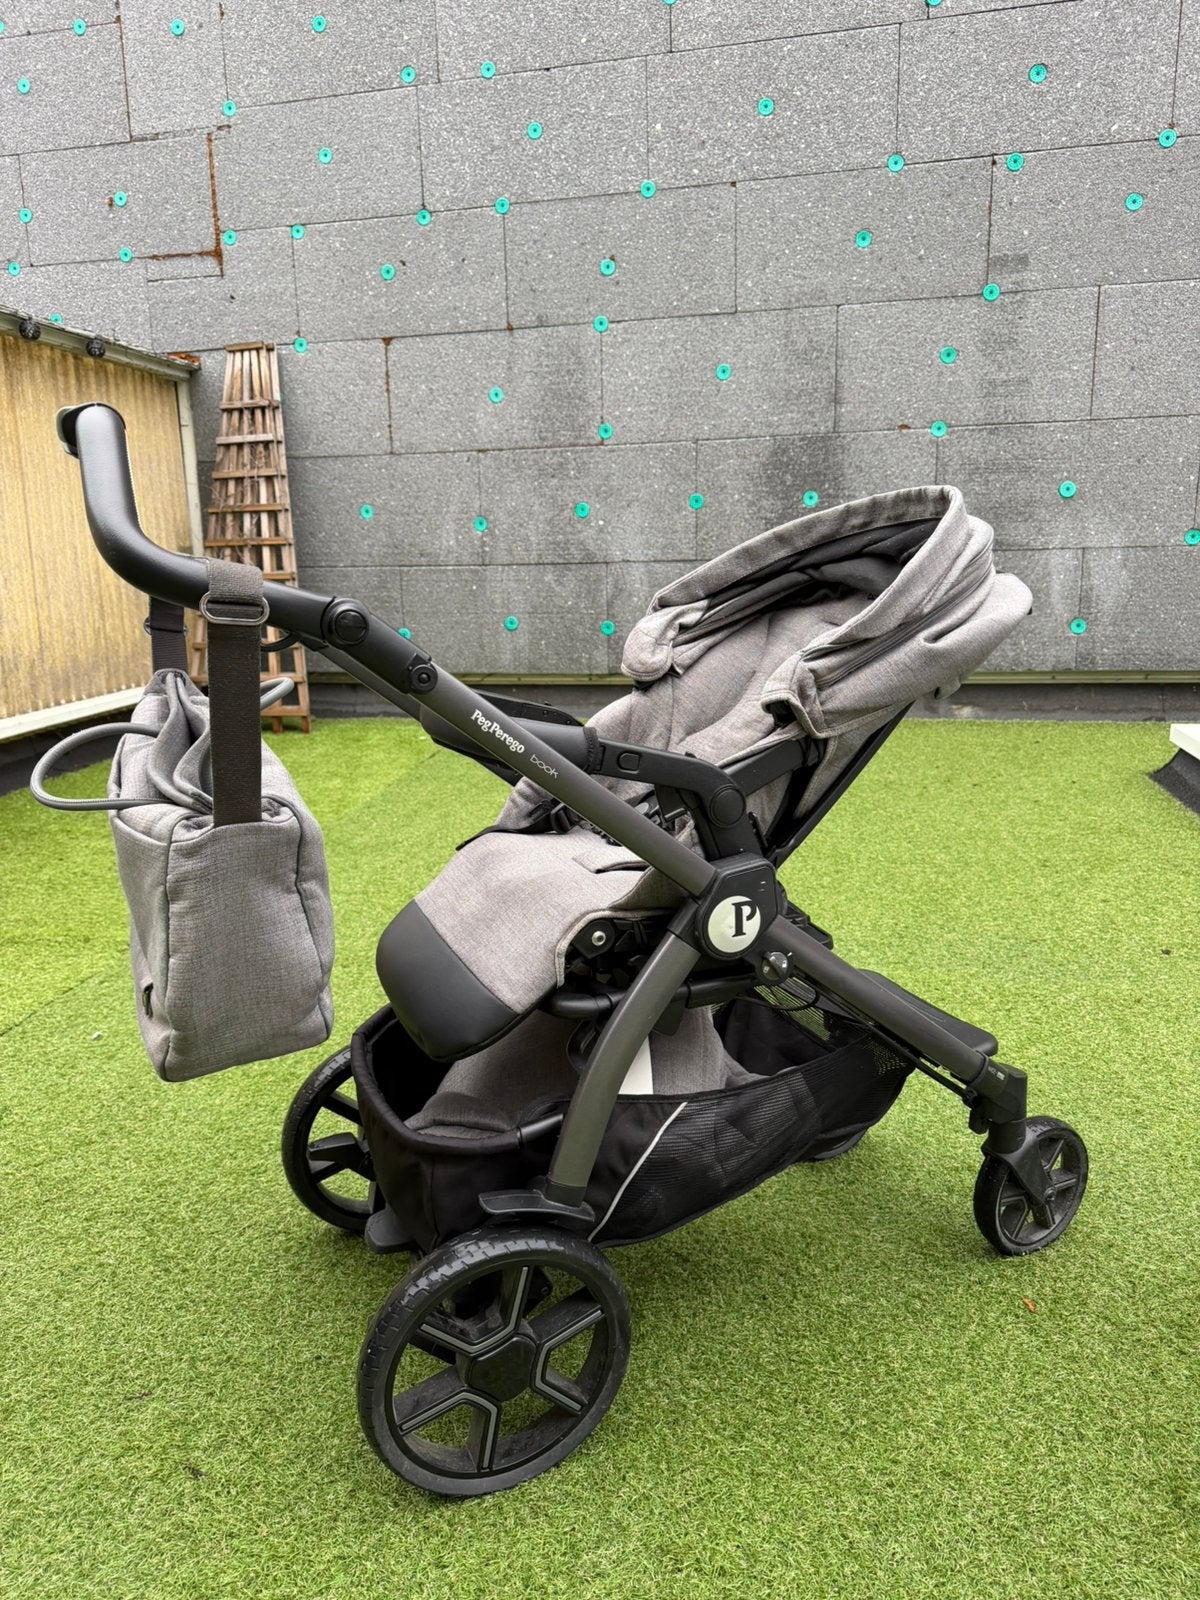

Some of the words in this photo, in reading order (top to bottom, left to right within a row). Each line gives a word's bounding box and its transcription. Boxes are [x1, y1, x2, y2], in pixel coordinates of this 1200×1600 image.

[470, 709, 525, 754] PegPerego
[530, 754, 559, 779] book
[731, 901, 758, 938] P
